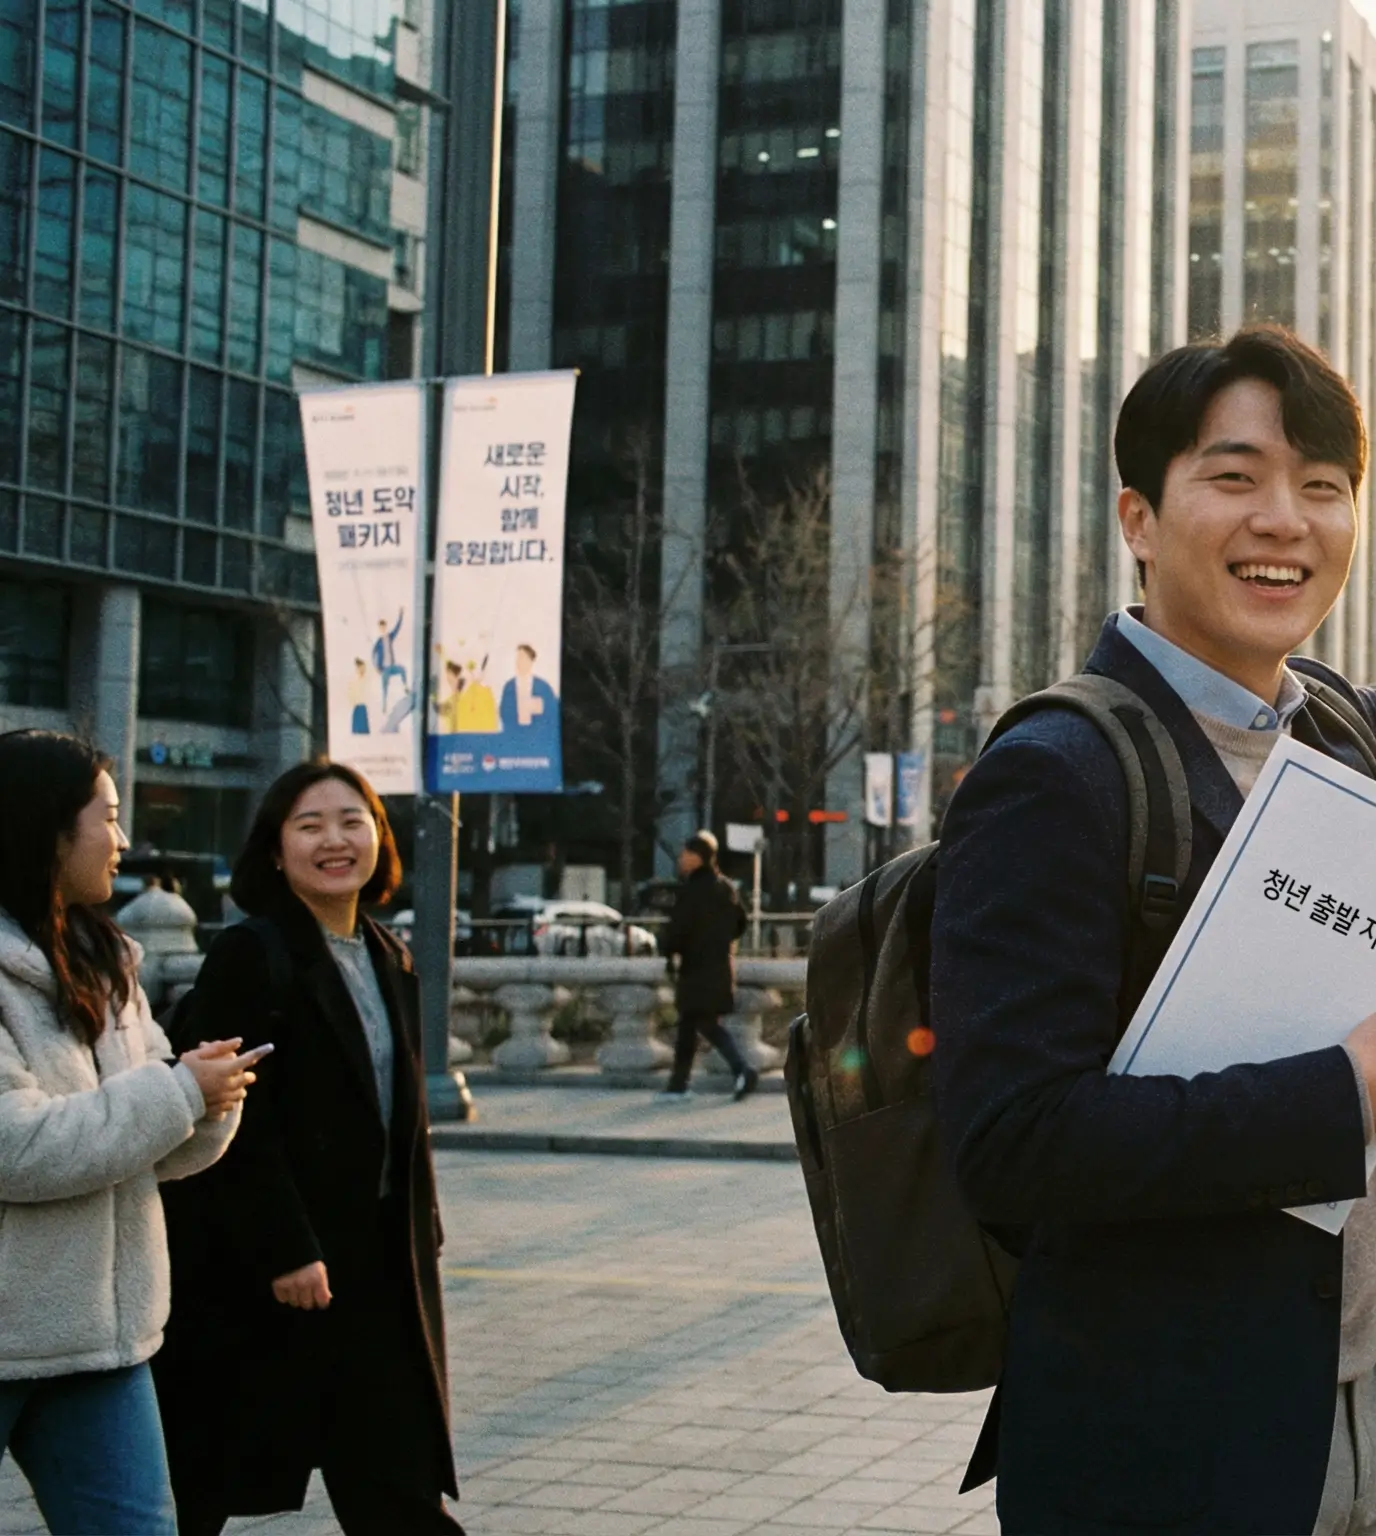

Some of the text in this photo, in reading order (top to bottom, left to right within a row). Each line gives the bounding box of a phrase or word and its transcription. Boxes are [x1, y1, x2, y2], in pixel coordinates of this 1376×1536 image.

[484, 442, 546, 468] 새로운
[325, 486, 416, 517] 청년 도약
[500, 507, 538, 533] 함께
[445, 539, 555, 567] 응원합니다.
[1263, 869, 1312, 912] 청년
[1309, 893, 1361, 937] 출발
